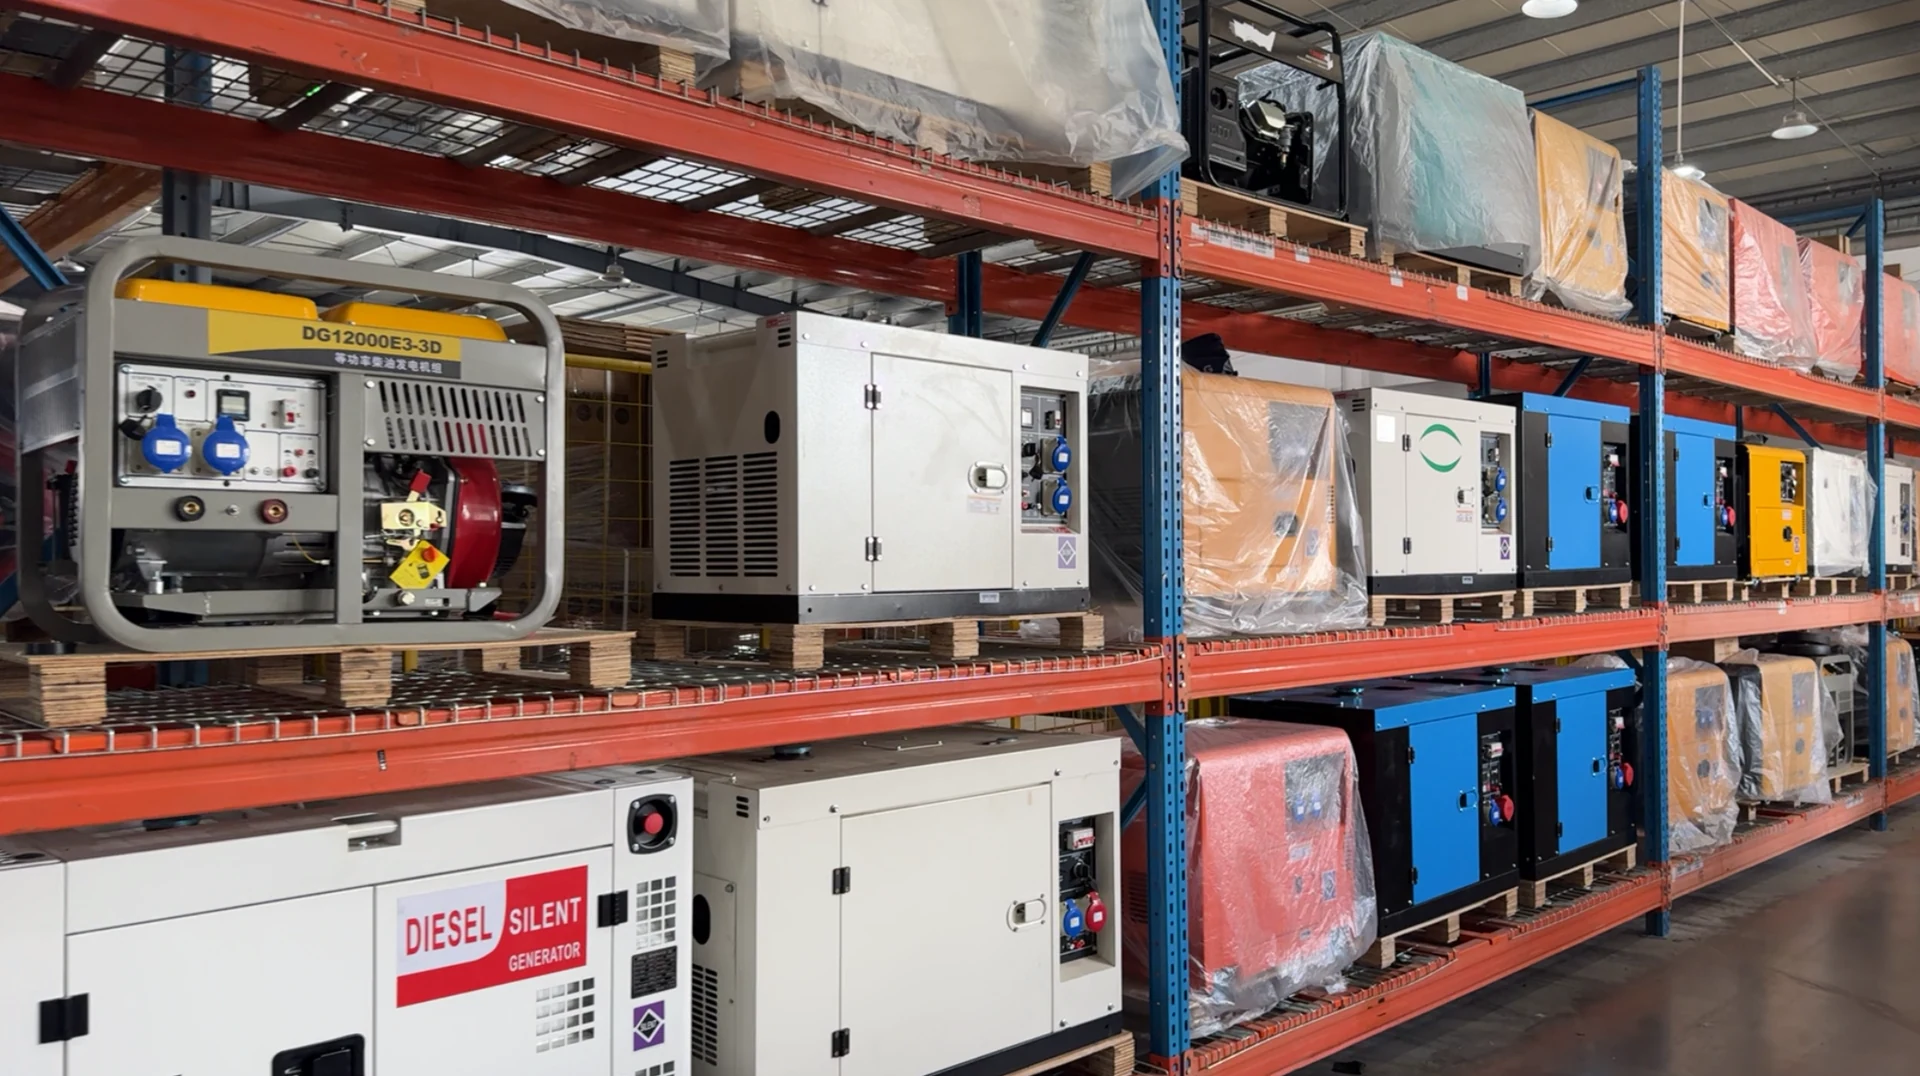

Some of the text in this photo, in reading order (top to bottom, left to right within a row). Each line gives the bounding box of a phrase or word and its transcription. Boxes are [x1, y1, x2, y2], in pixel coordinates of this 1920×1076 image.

[302, 326, 442, 354] DG12000E3-3D
[406, 897, 581, 955] DIESEL SILENT
[508, 942, 581, 972] GENERATOR
